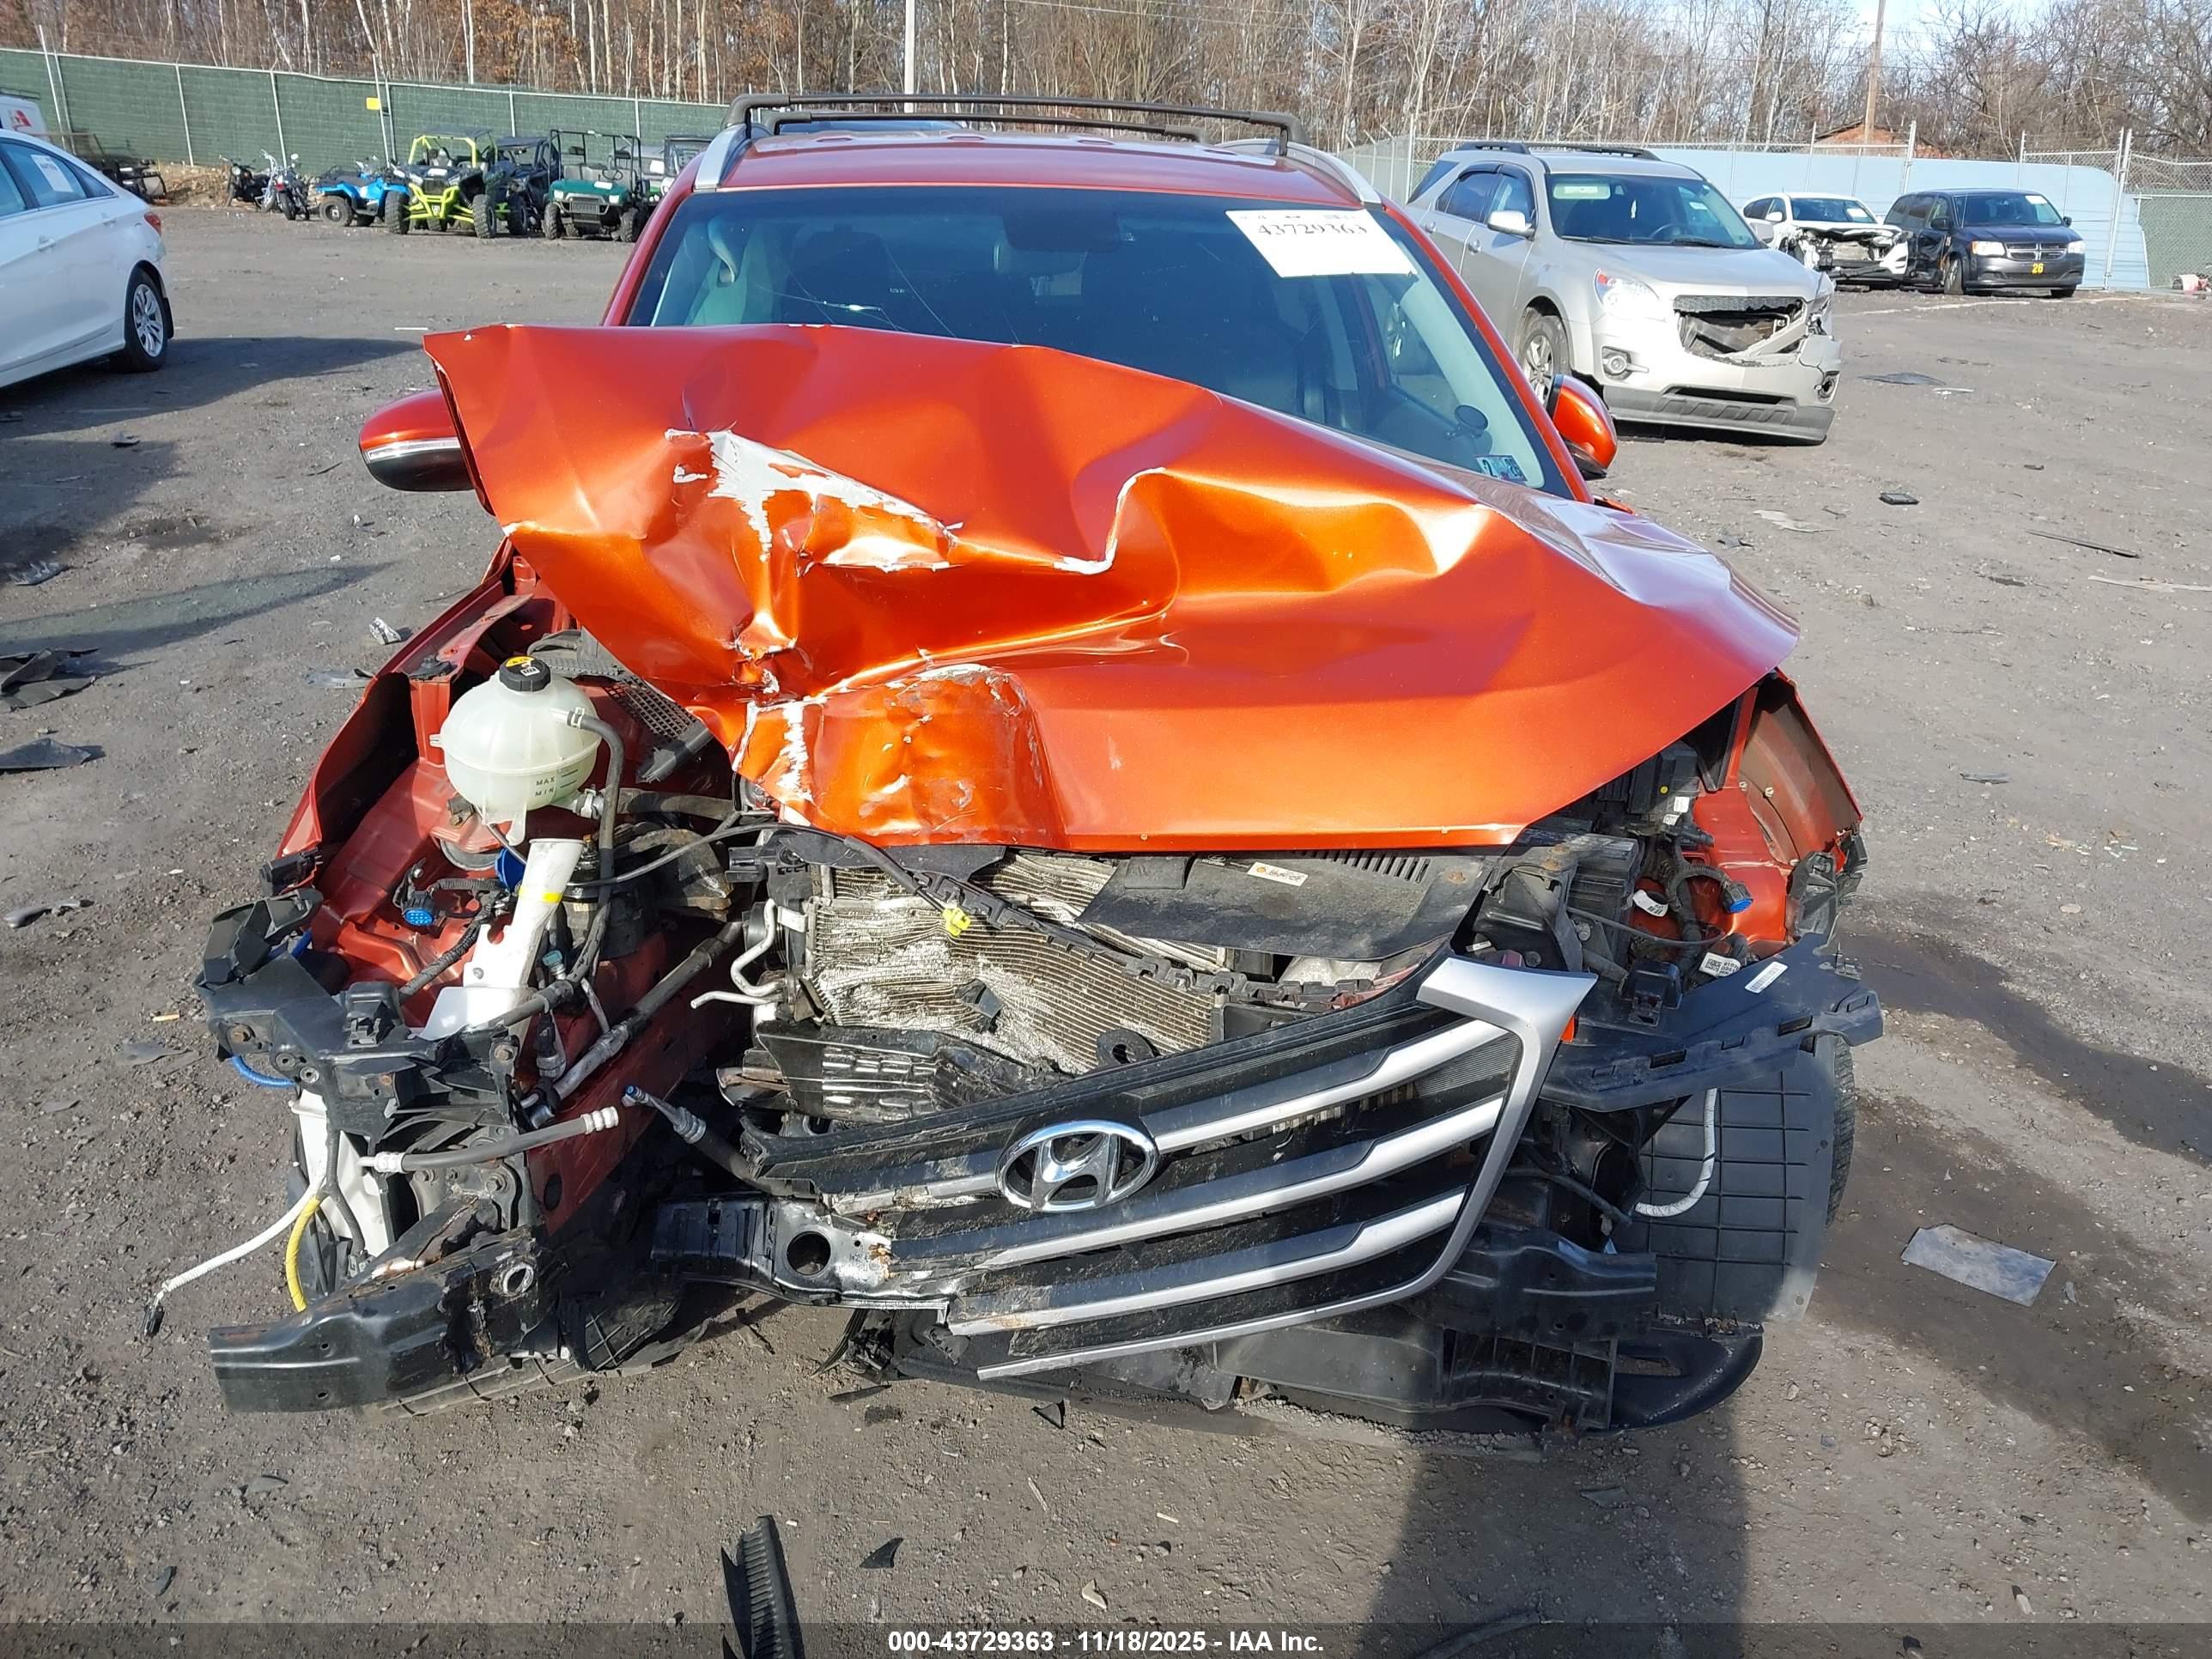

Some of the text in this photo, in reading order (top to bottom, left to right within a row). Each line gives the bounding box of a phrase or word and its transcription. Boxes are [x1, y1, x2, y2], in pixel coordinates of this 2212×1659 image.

[1259, 223, 1367, 234] 43729363
[2032, 263, 2044, 274] 26
[536, 776, 555, 786] MAX
[535, 787, 554, 797] MIN
